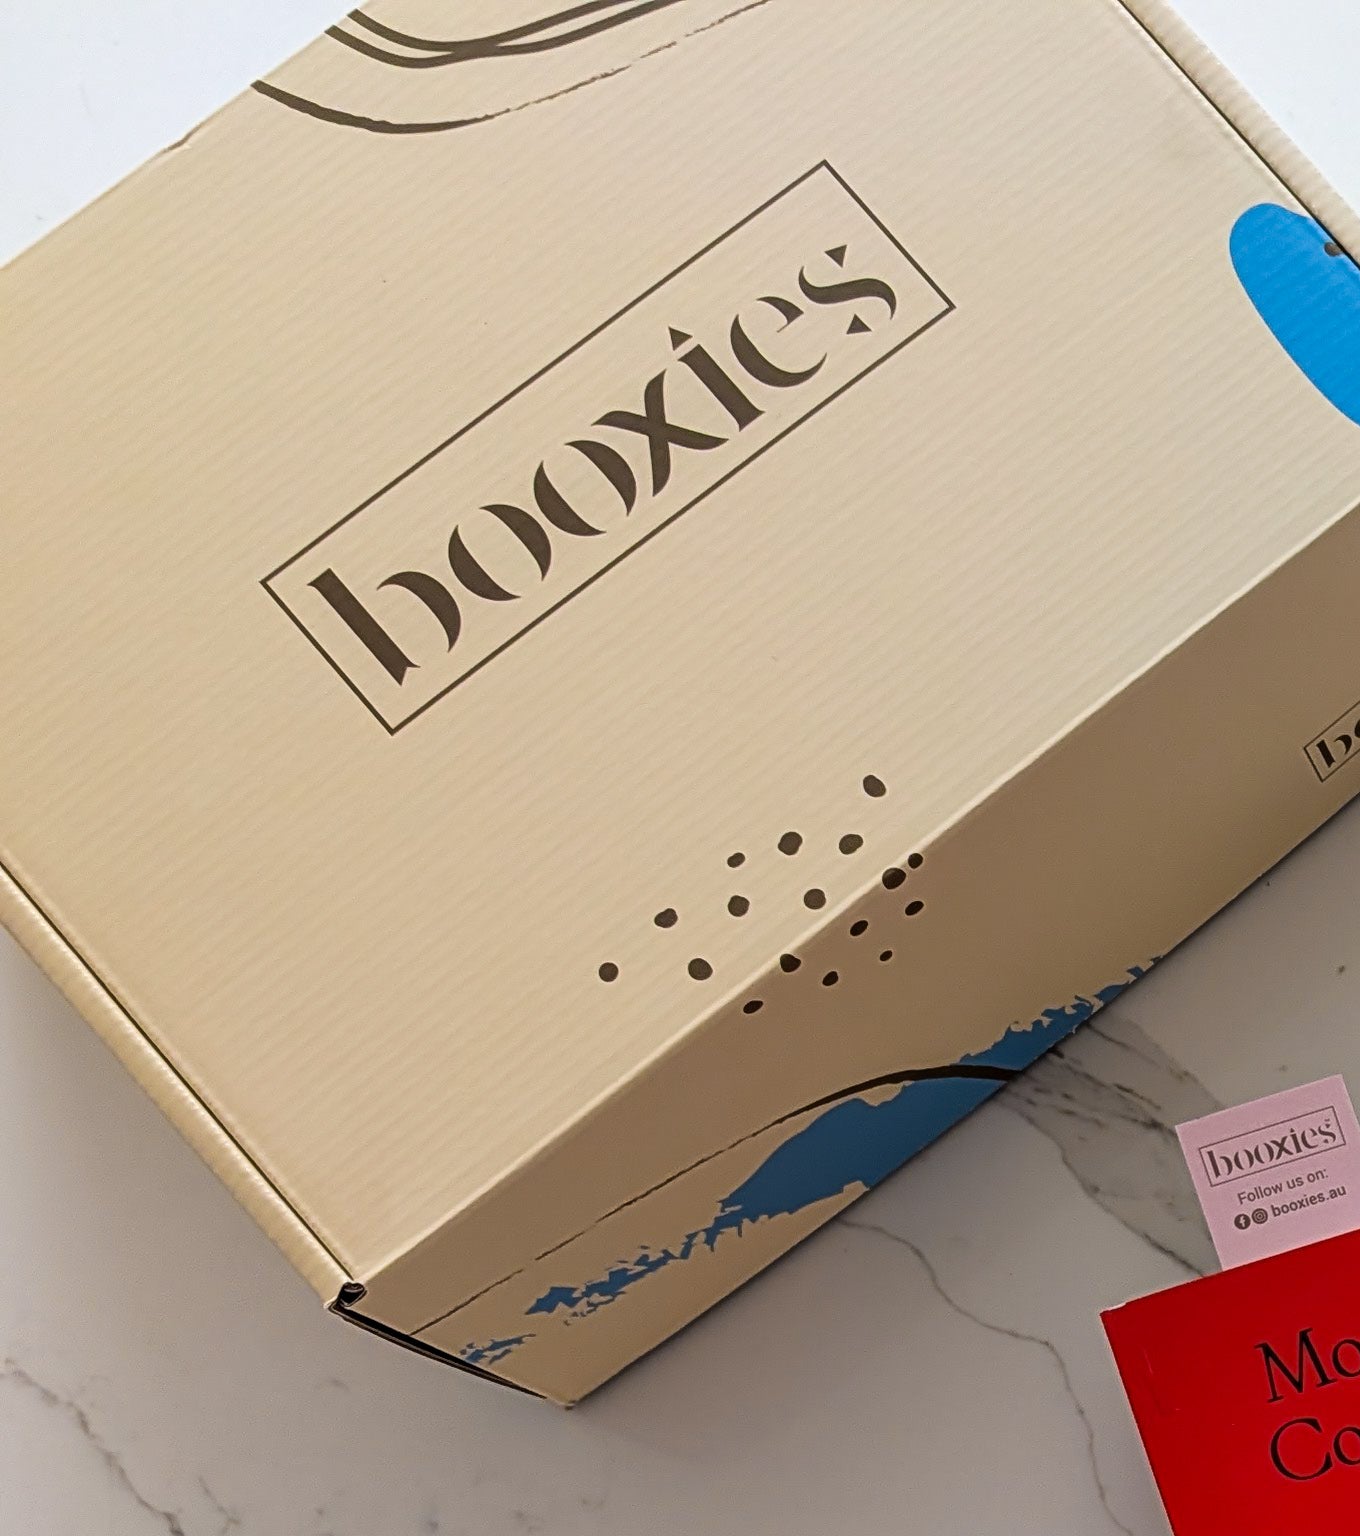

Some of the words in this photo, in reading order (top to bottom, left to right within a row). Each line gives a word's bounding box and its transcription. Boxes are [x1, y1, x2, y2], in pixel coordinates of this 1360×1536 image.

[307, 244, 899, 686] booxies
[1207, 1121, 1337, 1179] booxies
[1237, 1183, 1283, 1205] Follow
[1286, 1176, 1305, 1190] us
[1306, 1168, 1329, 1183] on:
[1271, 1185, 1347, 1217] booxies.au
